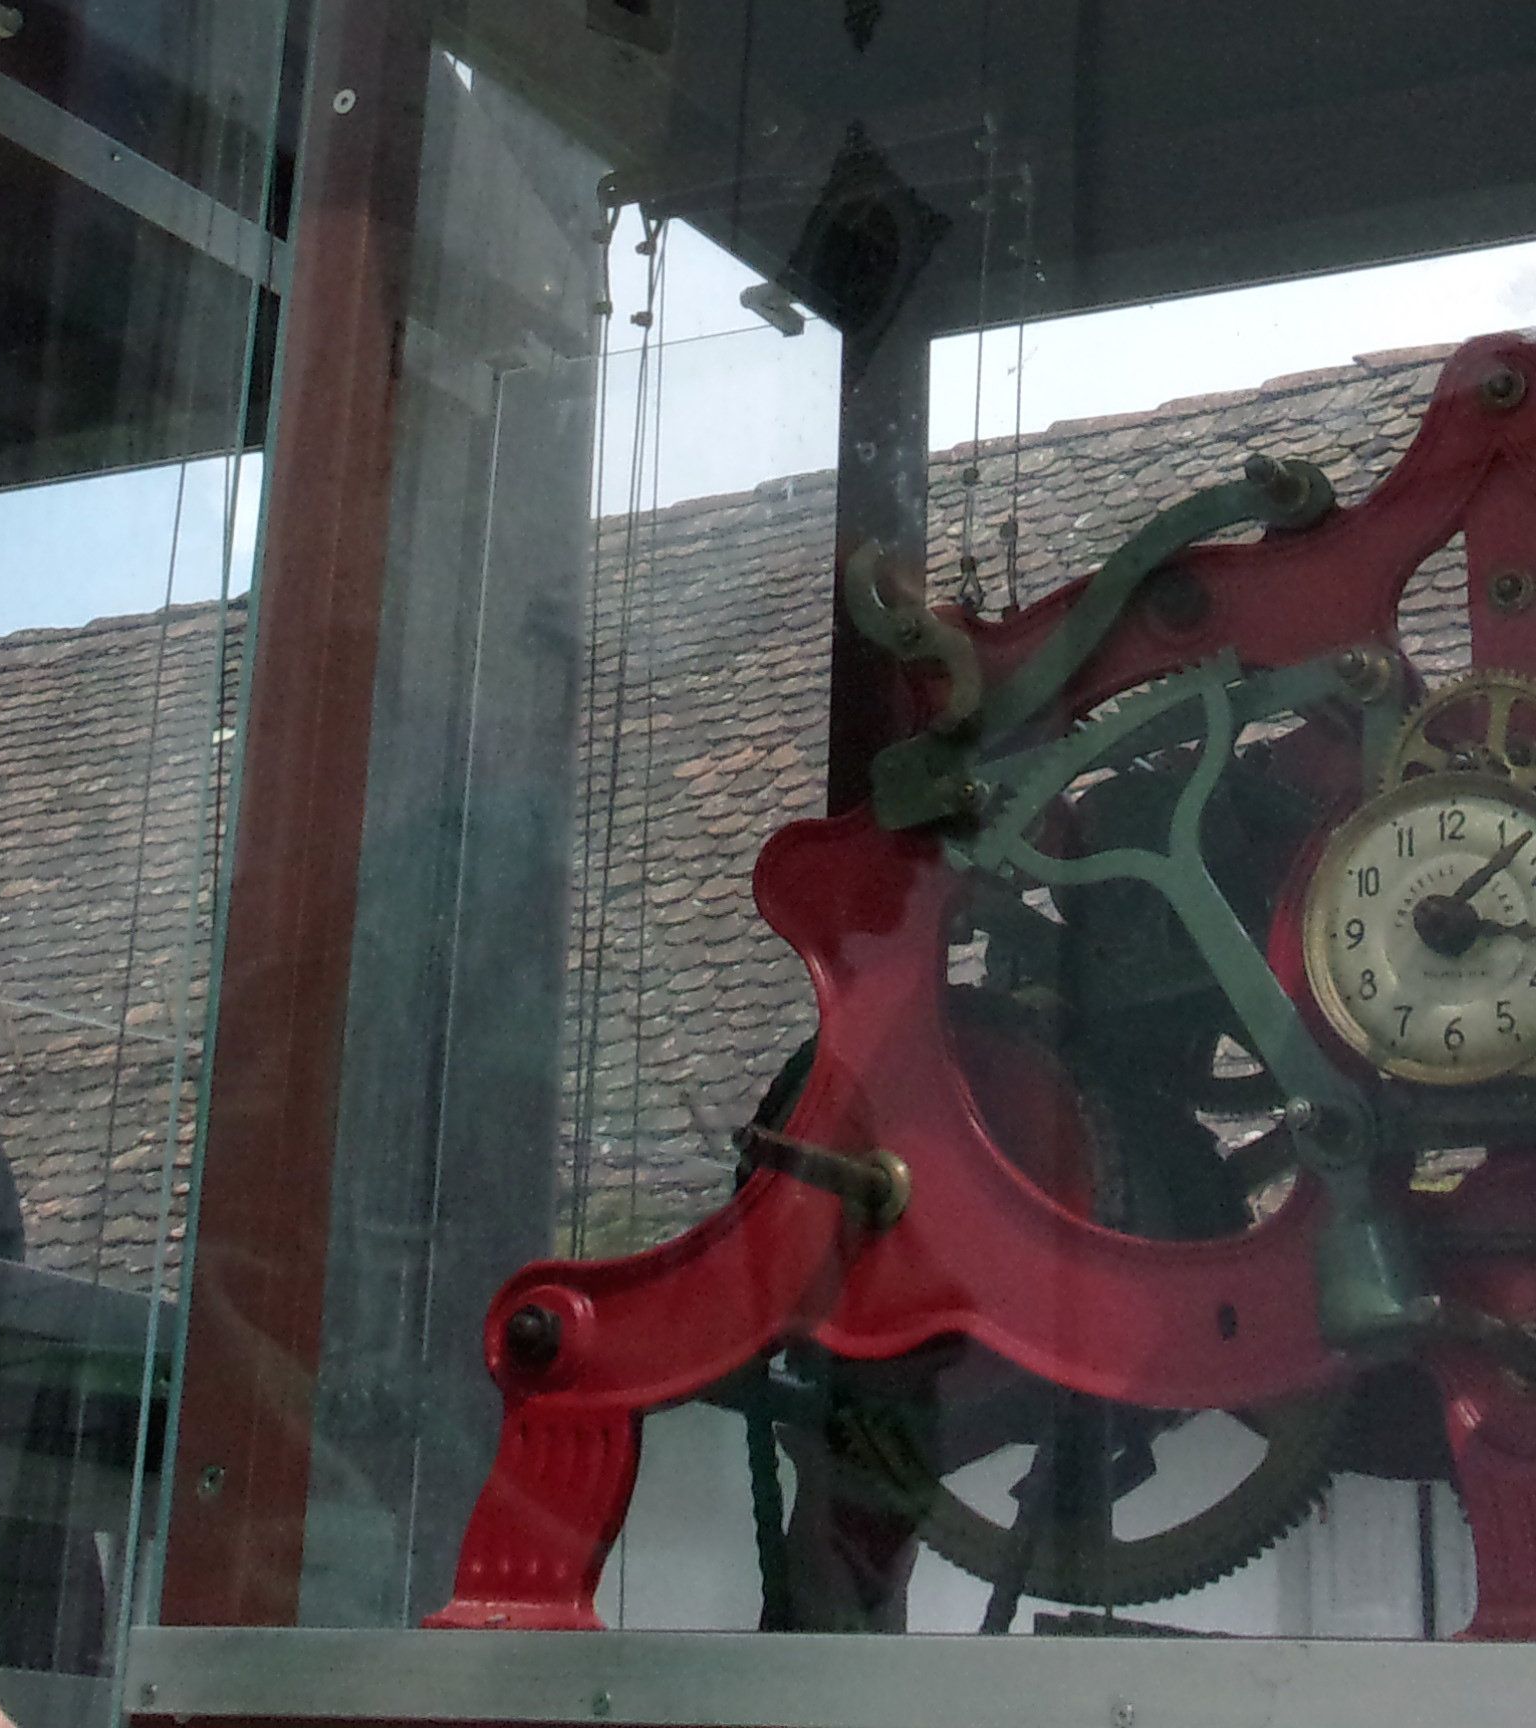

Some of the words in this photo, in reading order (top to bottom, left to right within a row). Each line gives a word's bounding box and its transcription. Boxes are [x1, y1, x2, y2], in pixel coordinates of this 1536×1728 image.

[1397, 826, 1414, 858] 11
[1439, 809, 1466, 842] 12
[1496, 819, 1506, 849] 1
[1356, 865, 1381, 898] 10
[1344, 917, 1365, 950] 9
[1358, 968, 1378, 1001] 8
[1393, 1004, 1413, 1038] 7
[1495, 1000, 1516, 1034] 5
[1443, 1017, 1465, 1051] 6
